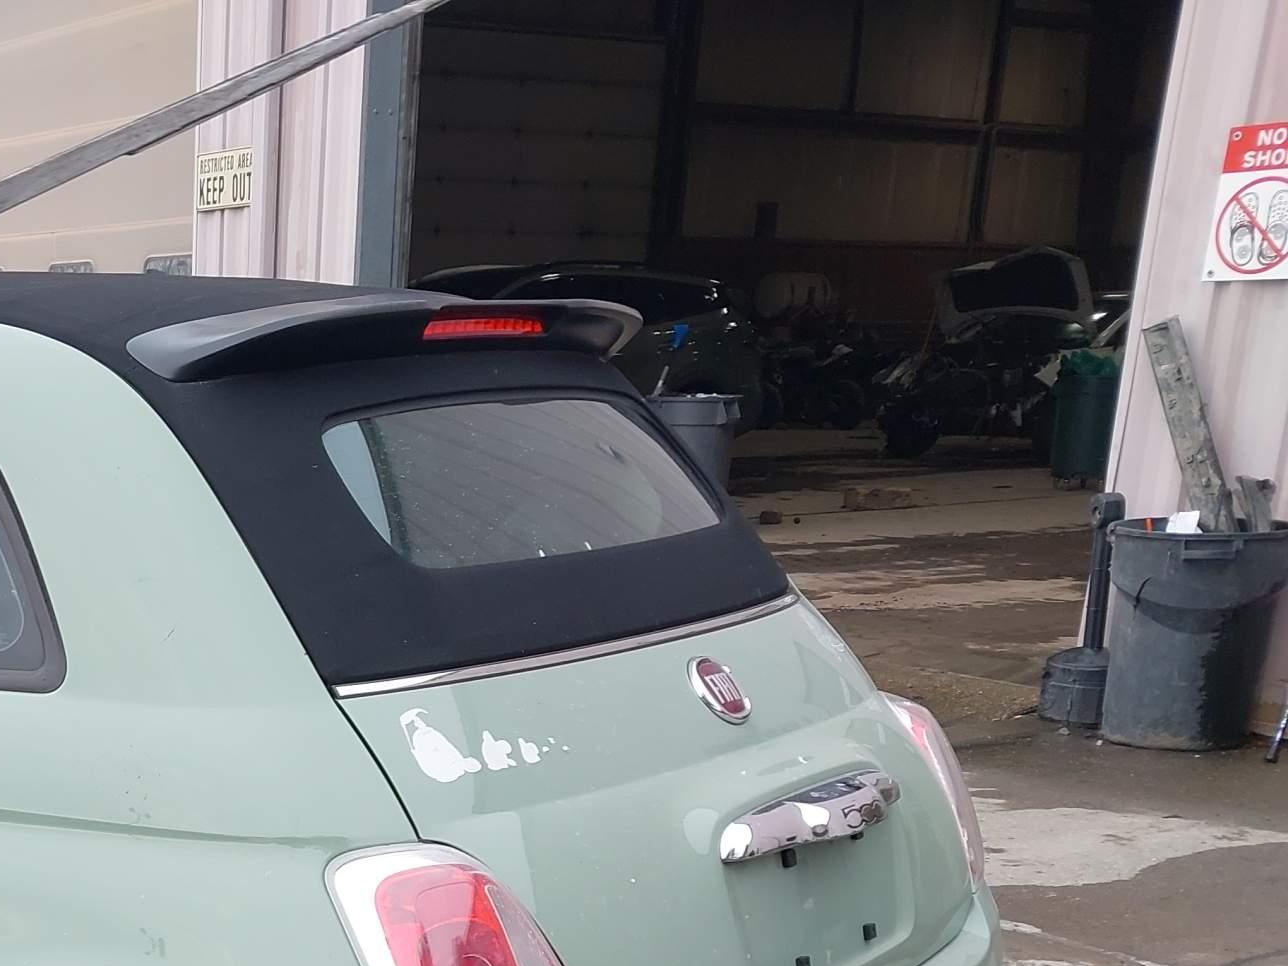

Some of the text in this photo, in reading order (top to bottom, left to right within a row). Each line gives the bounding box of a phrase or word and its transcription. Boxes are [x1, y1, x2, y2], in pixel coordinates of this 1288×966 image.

[1257, 127, 1288, 146] NO
[200, 154, 234, 174] RESTRICTED
[1241, 148, 1288, 168] SHO
[199, 172, 253, 206] KEEP OUT
[704, 672, 742, 705] FIAT
